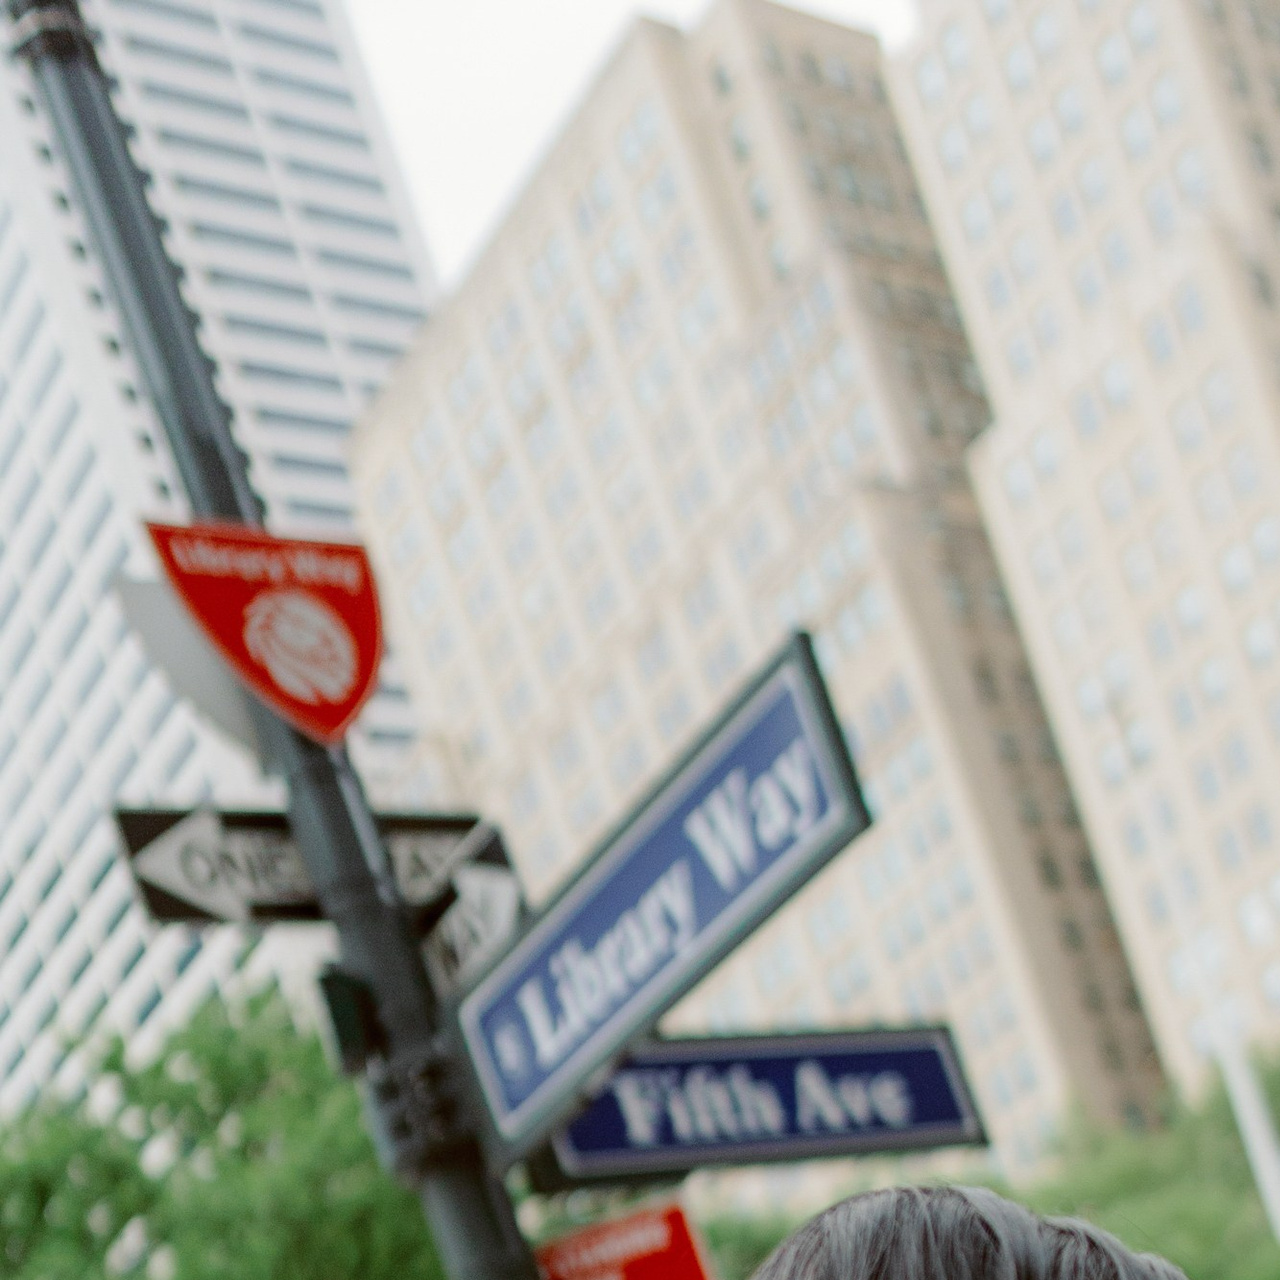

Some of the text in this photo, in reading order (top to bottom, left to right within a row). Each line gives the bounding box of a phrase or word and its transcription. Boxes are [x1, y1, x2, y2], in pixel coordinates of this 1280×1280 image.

[516, 736, 821, 1066] Library Way
[612, 1058, 912, 1148] Fifth Ave
